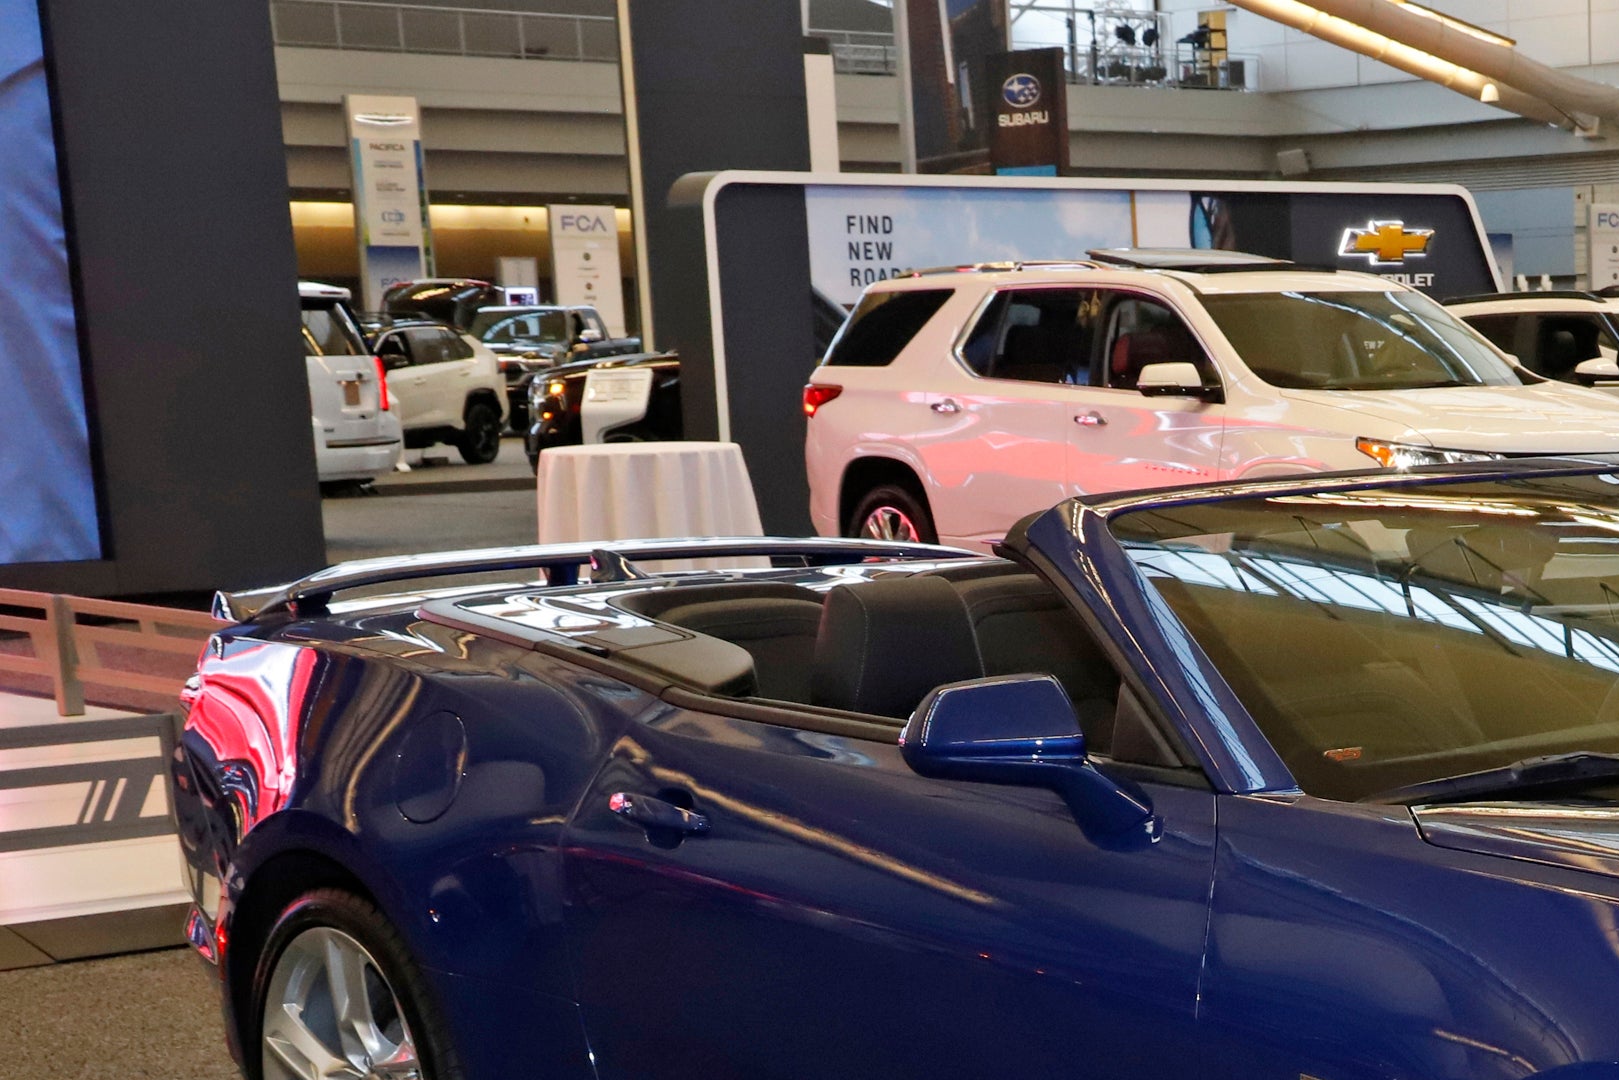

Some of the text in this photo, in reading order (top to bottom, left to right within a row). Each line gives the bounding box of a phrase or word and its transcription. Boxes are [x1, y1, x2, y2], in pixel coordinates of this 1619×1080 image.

[998, 110, 1049, 127] SUBARU
[560, 215, 607, 232] FCA
[846, 215, 893, 234] FIND
[848, 241, 893, 261] NEW
[850, 268, 912, 287] ROA
